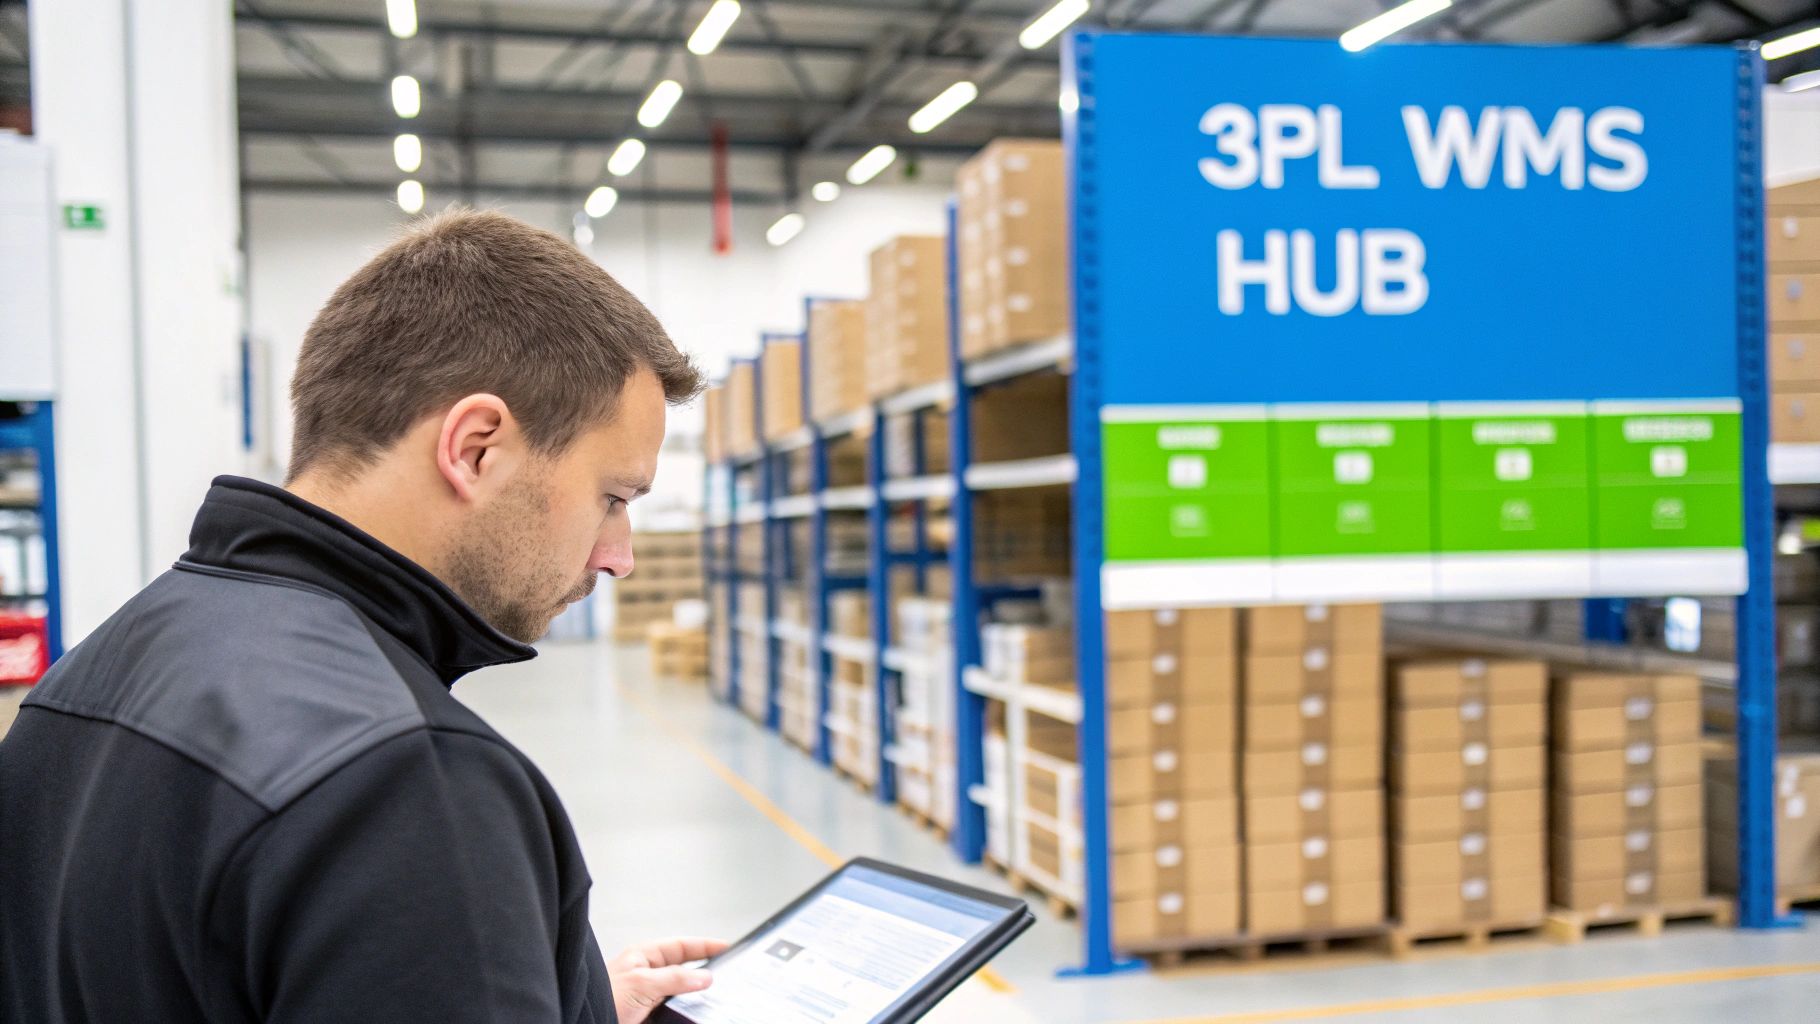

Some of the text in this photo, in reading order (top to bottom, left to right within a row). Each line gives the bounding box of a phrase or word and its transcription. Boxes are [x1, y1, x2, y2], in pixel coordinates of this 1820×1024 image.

[1199, 103, 1648, 191] 3PL WMS
[1216, 229, 1429, 316] HUB
